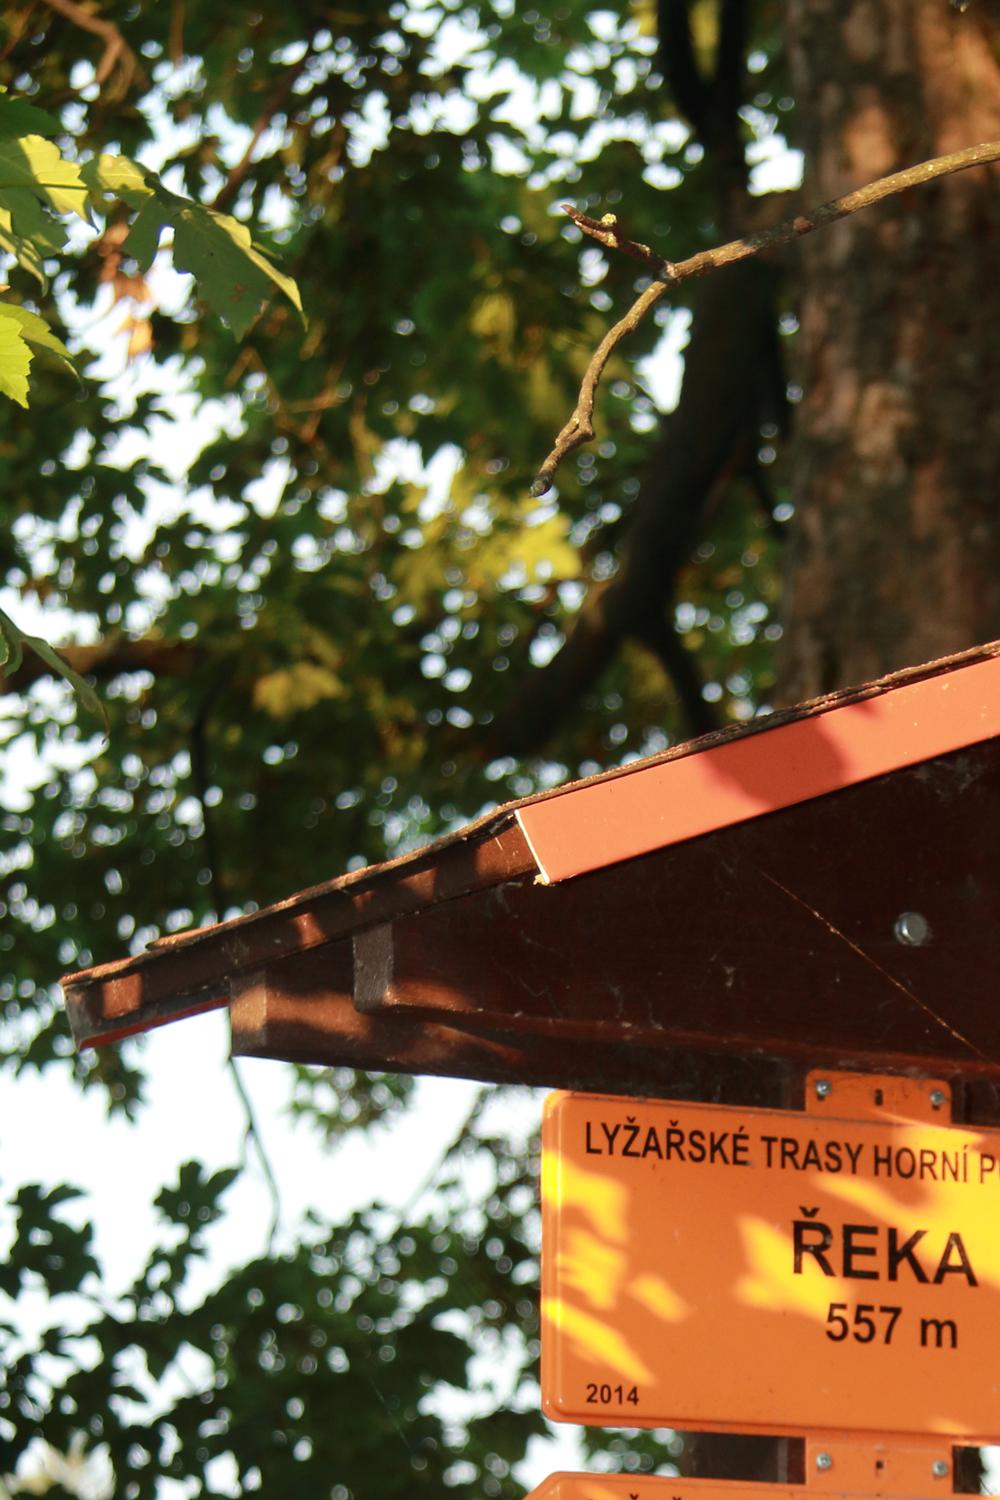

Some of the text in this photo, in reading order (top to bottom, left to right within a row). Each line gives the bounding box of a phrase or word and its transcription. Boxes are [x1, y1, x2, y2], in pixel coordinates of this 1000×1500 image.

[585, 1116, 750, 1167] LYŽAŘSKÉ
[761, 1135, 864, 1175] TRASY
[873, 1144, 970, 1184] HORNÍ
[792, 1207, 978, 1287] ŘEKA
[825, 1302, 959, 1349] 557 m
[585, 1383, 640, 1407] 2014
